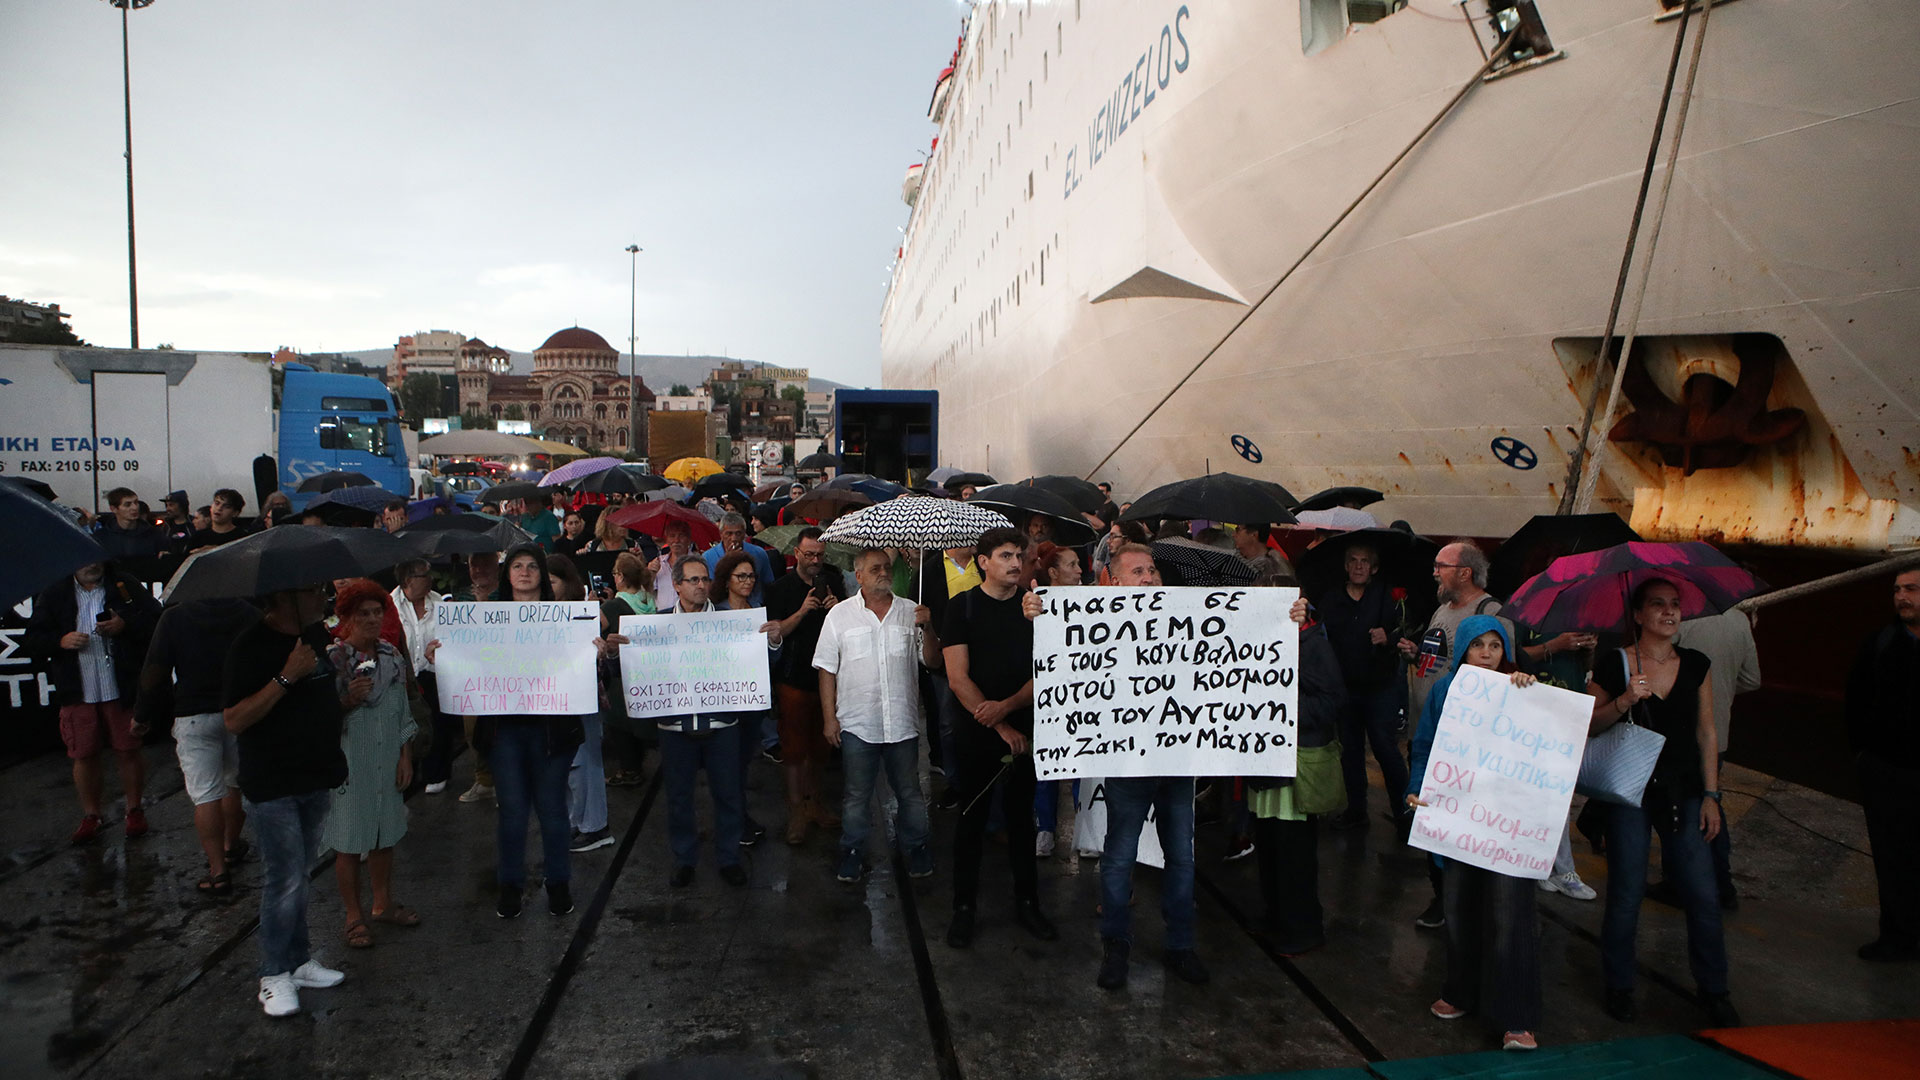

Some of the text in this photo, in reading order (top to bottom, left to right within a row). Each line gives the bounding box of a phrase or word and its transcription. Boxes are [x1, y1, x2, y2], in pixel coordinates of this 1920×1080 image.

[1064, 4, 1190, 200] EL. VENIZELOS
[21, 461, 51, 472] FAX:
[56, 461, 80, 472] 210
[123, 460, 139, 472] 09
[438, 604, 477, 625] BLACK
[484, 610, 511, 624] DEATH
[1065, 616, 1227, 646] ΠΟΛΕΜΟ
[1034, 653, 1058, 678] με
[1069, 647, 1118, 672] τους
[464, 676, 556, 693] ΔΙΚΑΙΟΣΥΝΗ
[630, 681, 758, 697] ΟΧΙ ΣΤΟΝ ΕΚΦΑΣΙΣΜΟ
[1037, 665, 1294, 710] αυτού του κόσμου
[1459, 671, 1509, 708] ΟΧΙ
[452, 693, 568, 712] ΓΙΑ ΤΟΝ ΑΝΤΩΝΗ
[628, 694, 767, 712] ΚΡΑΤΟΥΣ ΚΑΙ ΚΟΙΝΩΝΙΑΣ
[1111, 705, 1155, 725] τον
[1036, 746, 1070, 761] την
[1155, 732, 1192, 748] τον
[1432, 761, 1476, 793] ΟΧΙ
